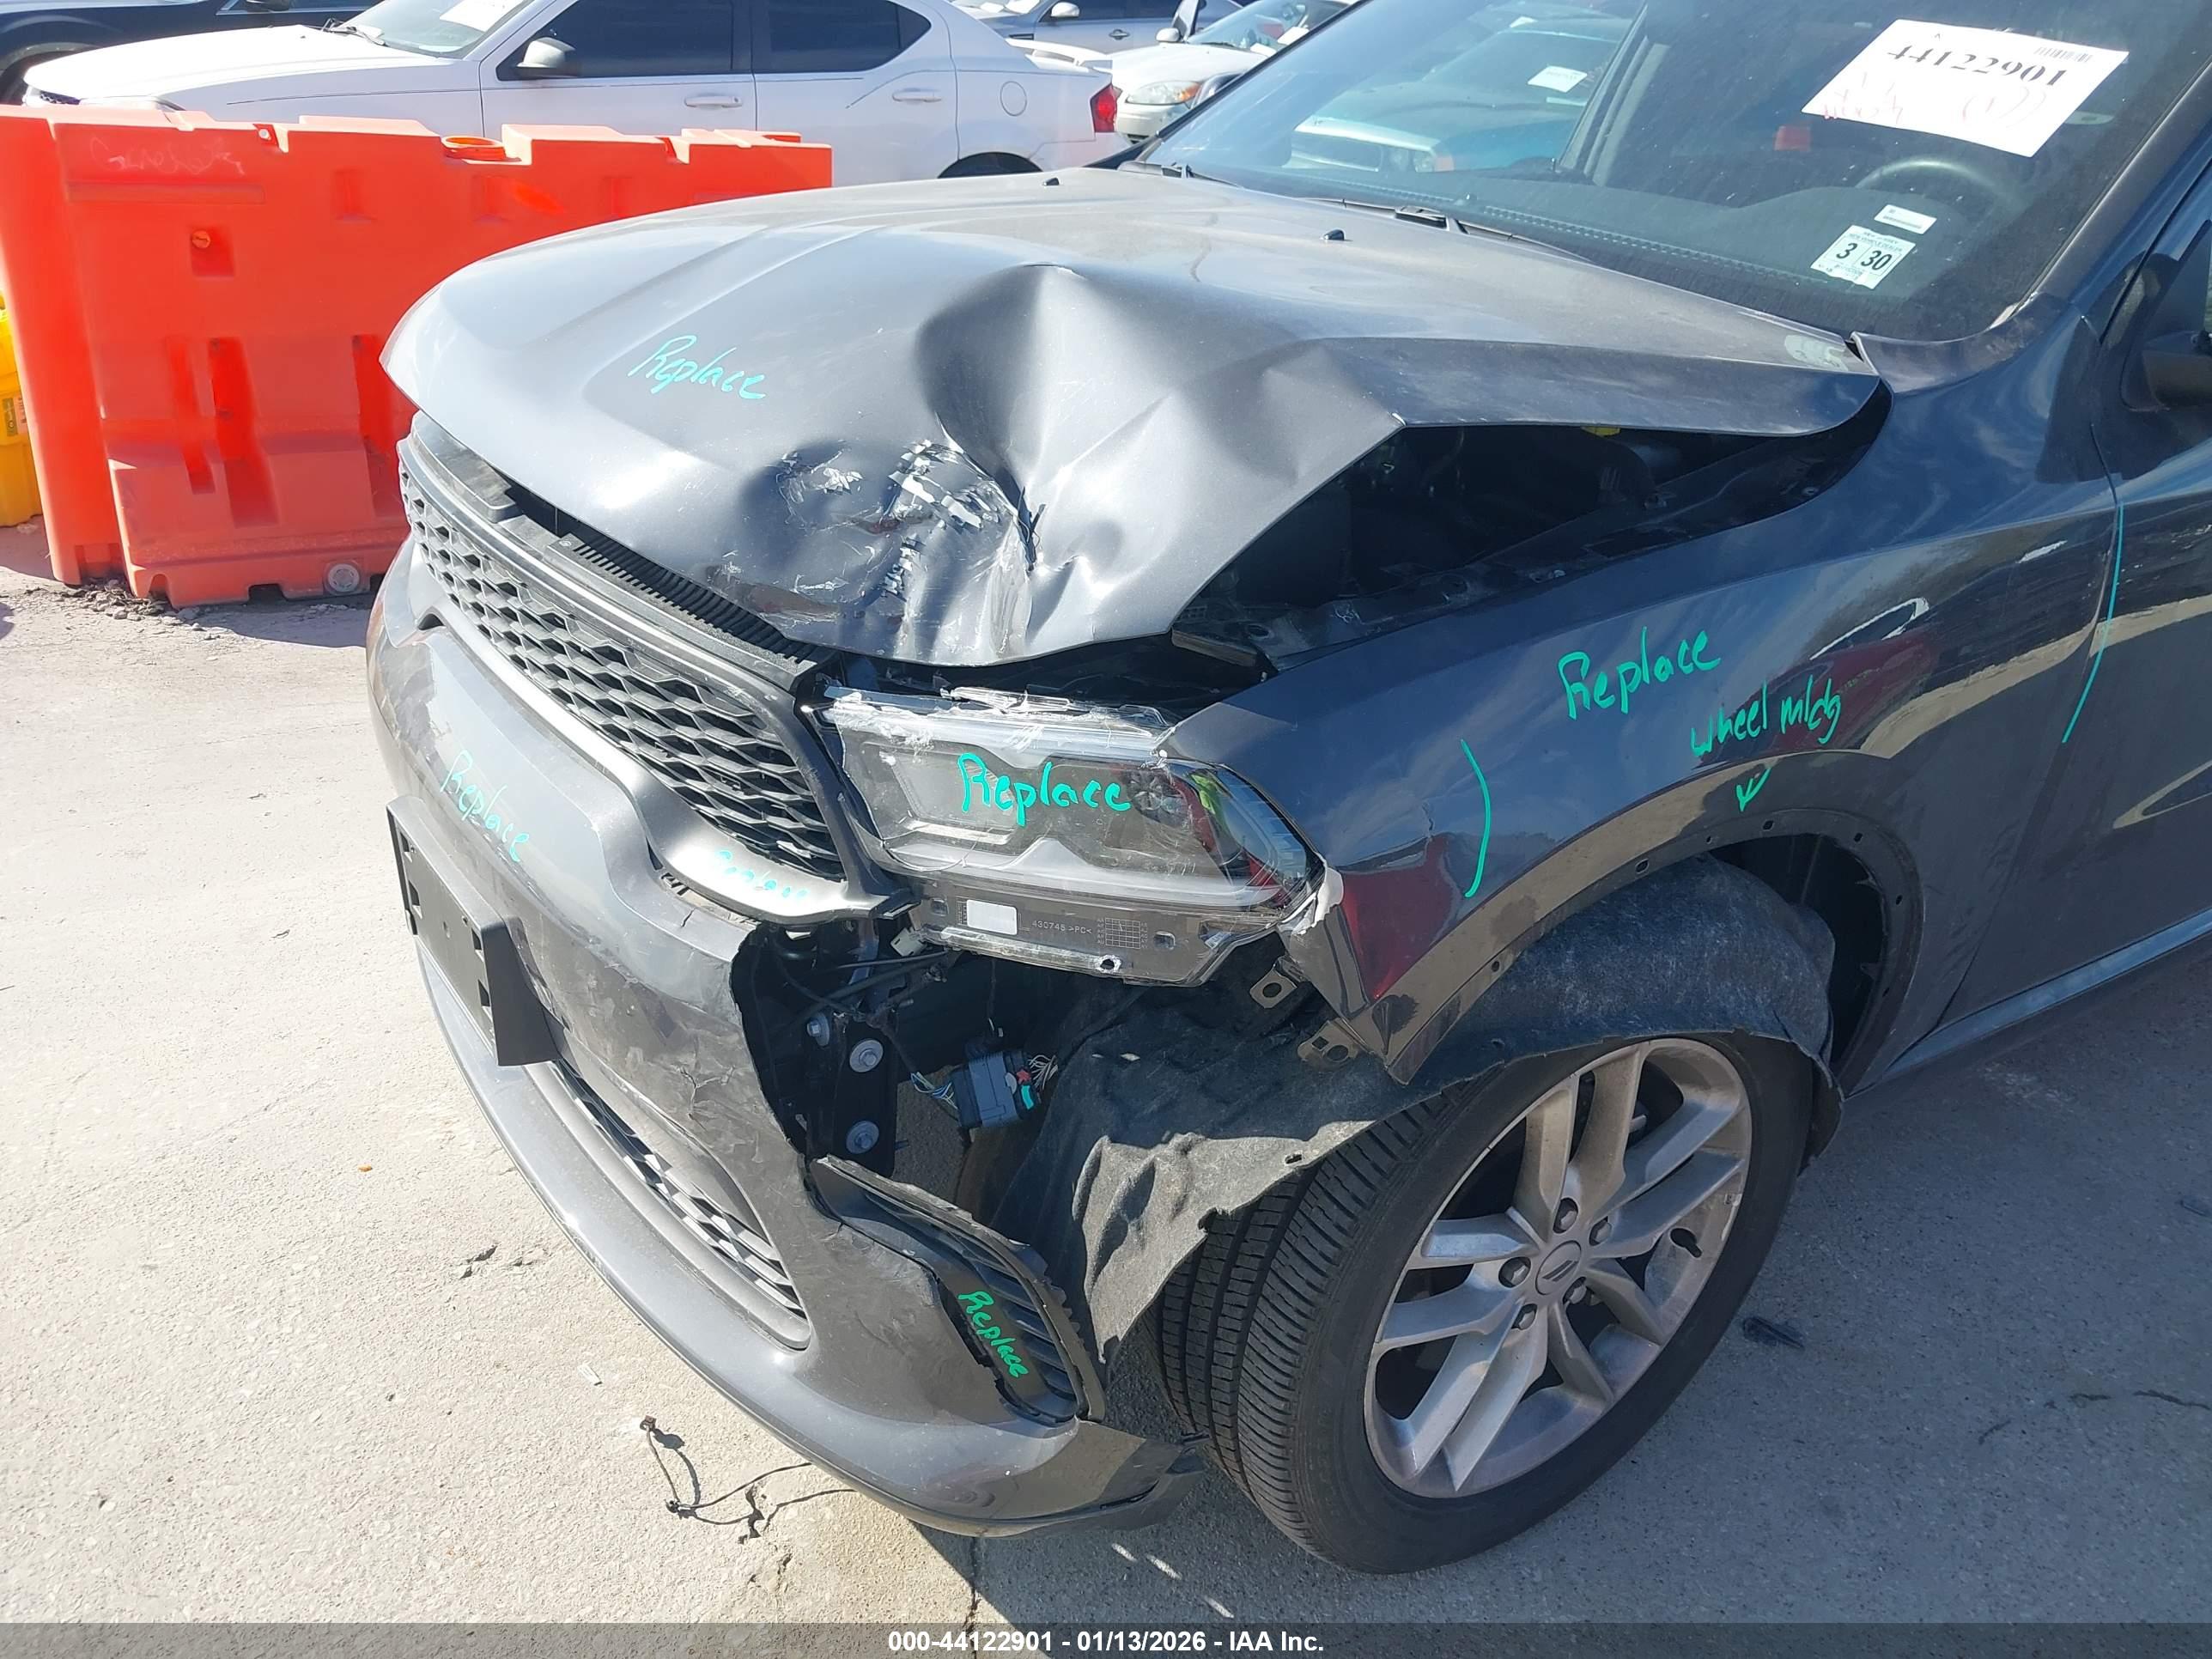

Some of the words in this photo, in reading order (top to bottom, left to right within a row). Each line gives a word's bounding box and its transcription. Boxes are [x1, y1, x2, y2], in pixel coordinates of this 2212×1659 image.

[1887, 45, 2067, 86] 44122901
[1836, 243, 1858, 259] 3
[1861, 250, 1893, 270] 30
[628, 335, 766, 399] Replace
[1557, 626, 1720, 720] Replace
[440, 749, 530, 863] Replace
[957, 752, 1132, 827] Replace
[957, 1291, 1030, 1378] Replace
